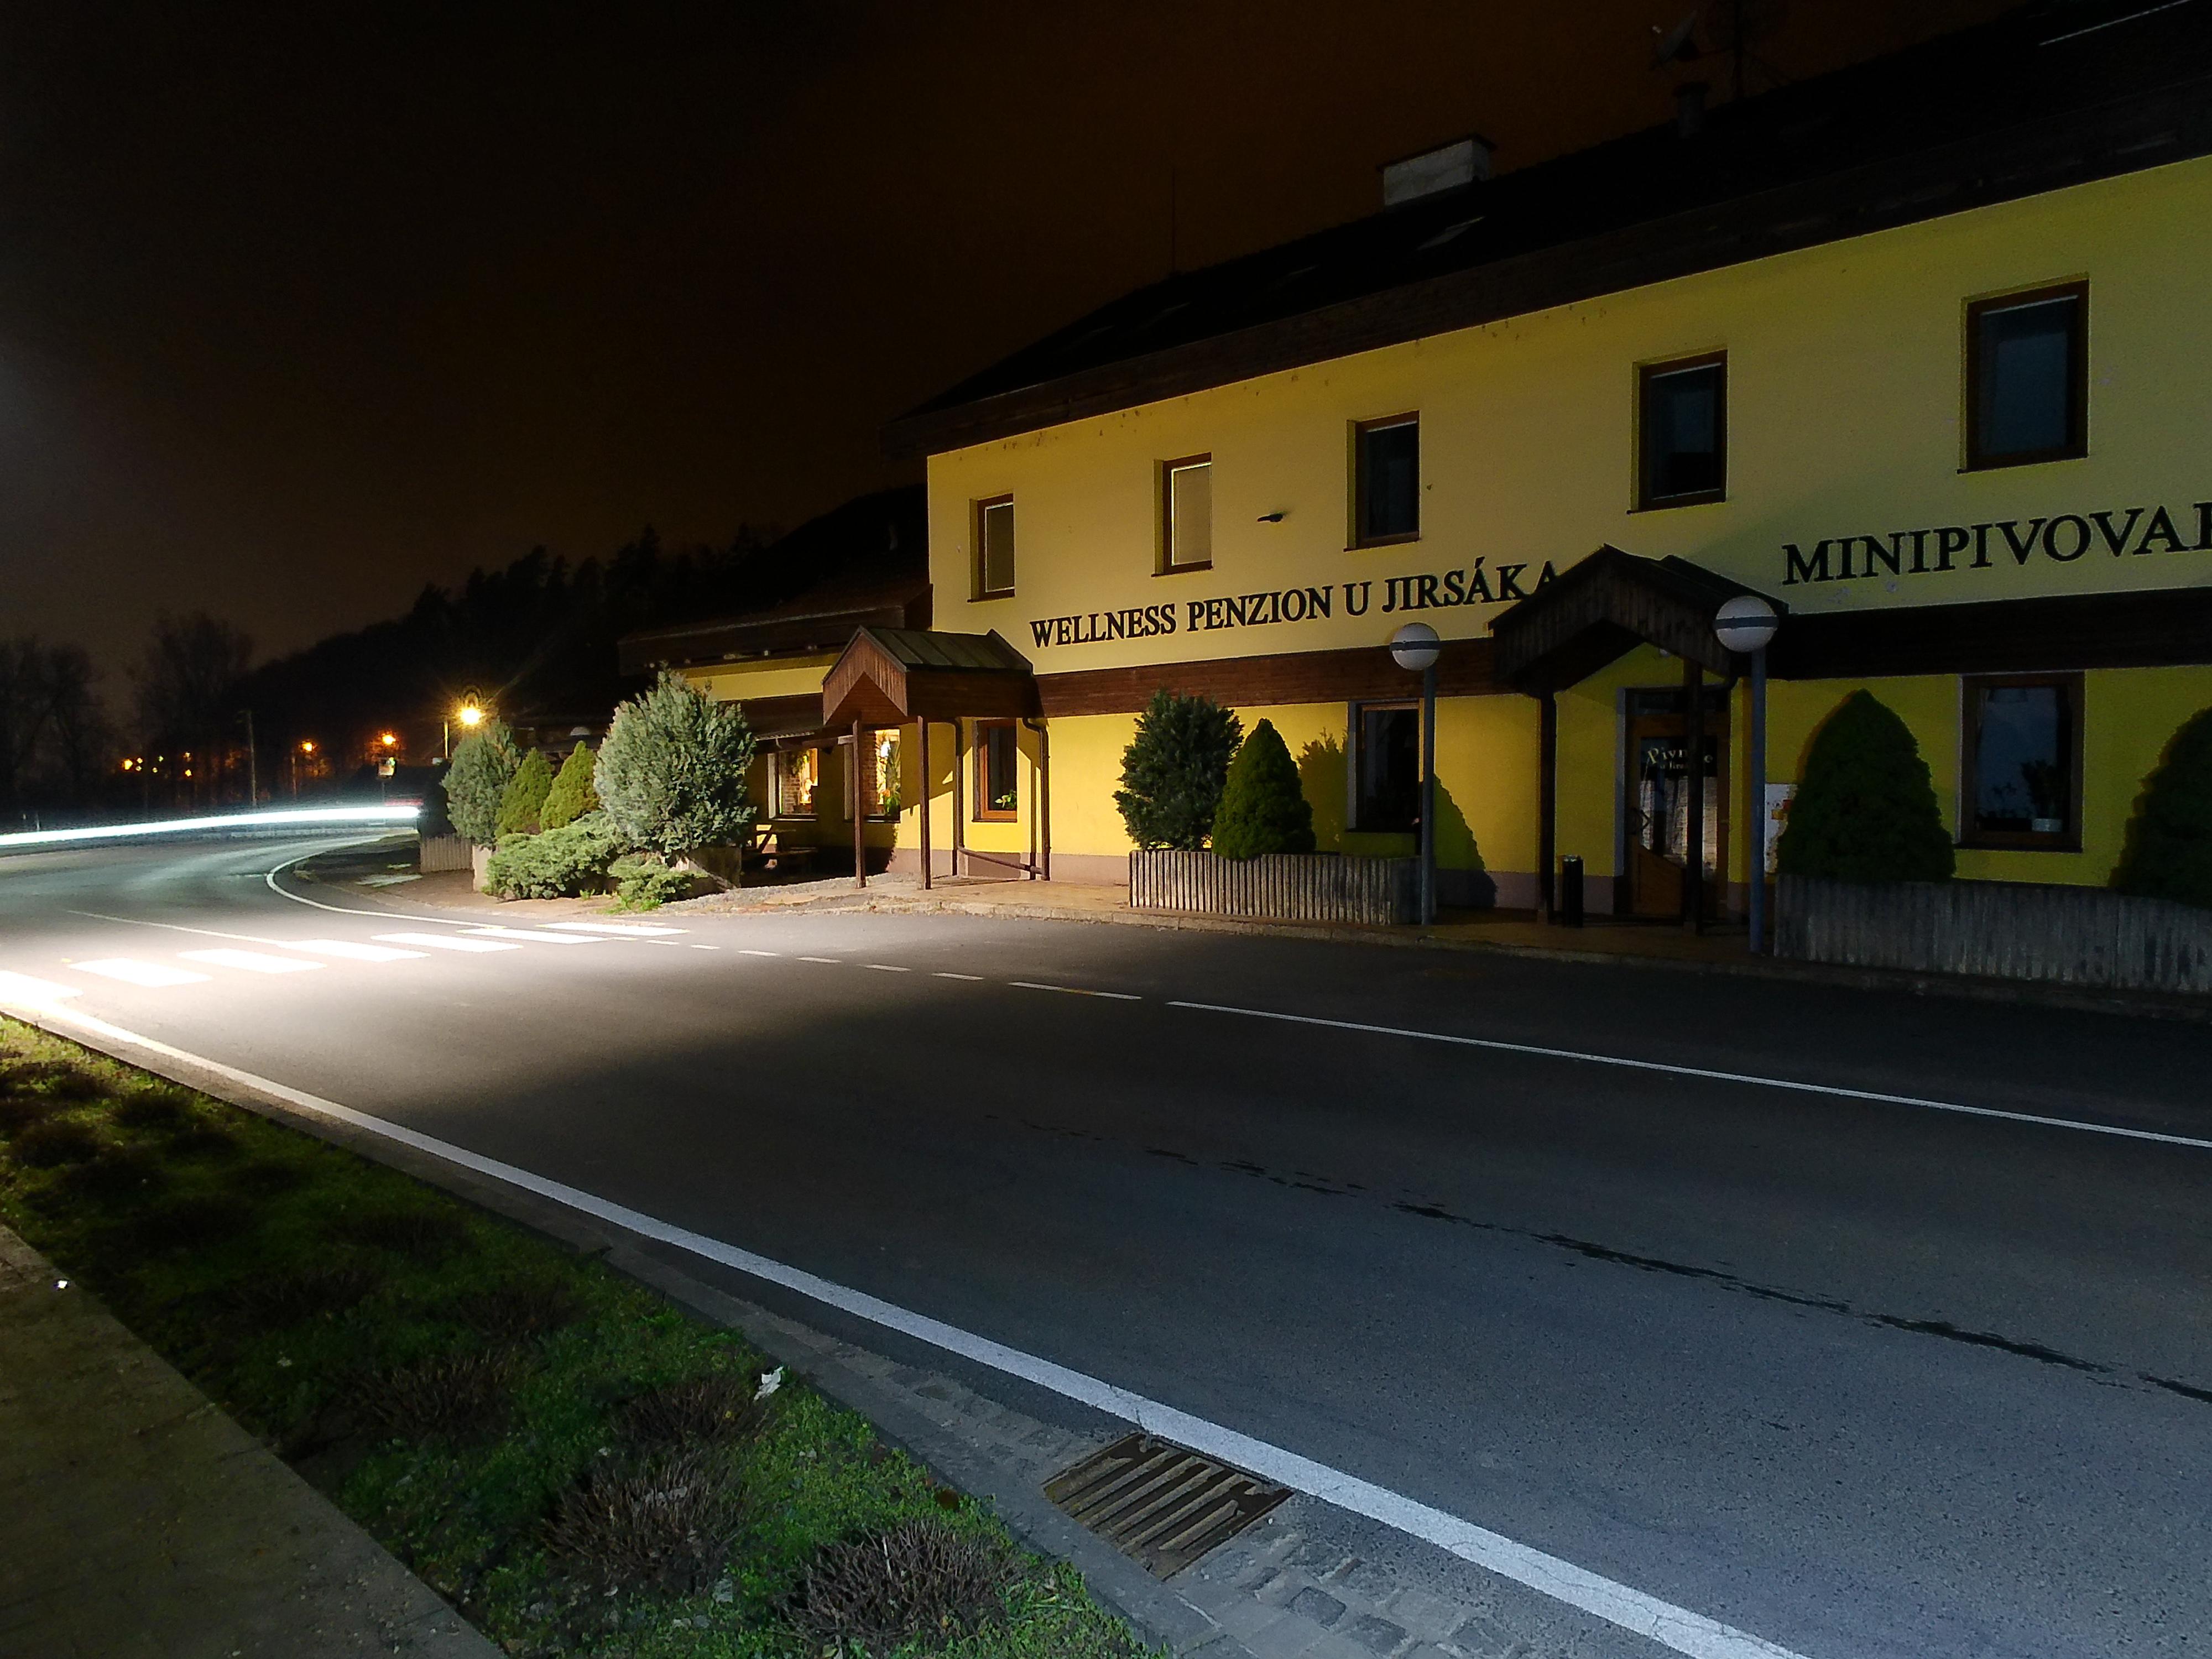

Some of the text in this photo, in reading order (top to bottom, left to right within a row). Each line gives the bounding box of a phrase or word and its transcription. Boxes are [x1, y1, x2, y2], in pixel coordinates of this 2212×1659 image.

[1030, 603, 1176, 648] WELLNESS
[1186, 586, 1333, 632] PENZION
[1342, 581, 1372, 616] U
